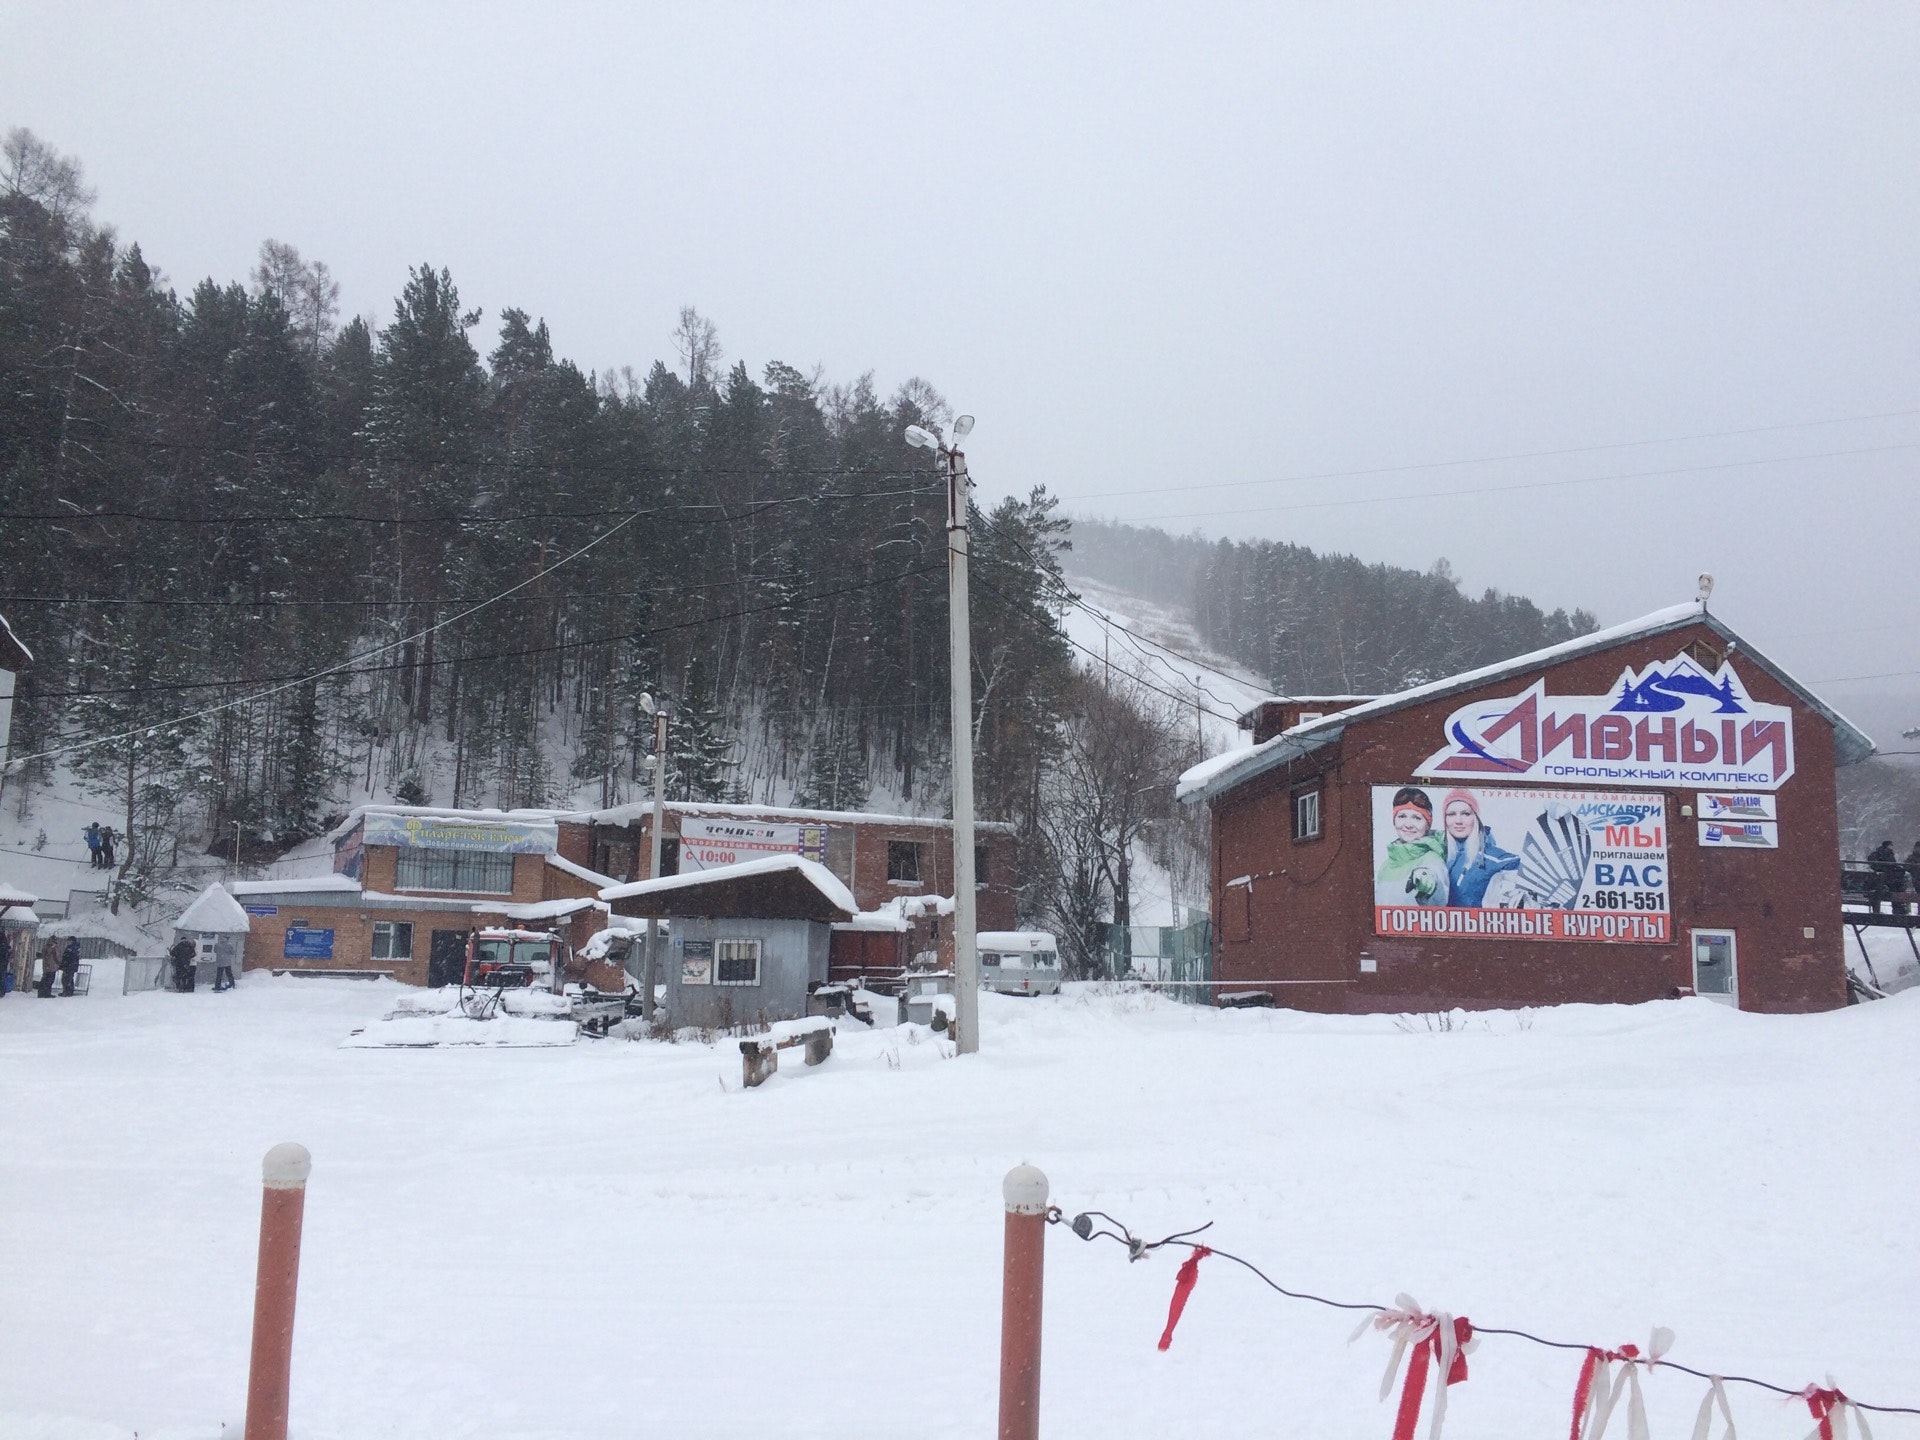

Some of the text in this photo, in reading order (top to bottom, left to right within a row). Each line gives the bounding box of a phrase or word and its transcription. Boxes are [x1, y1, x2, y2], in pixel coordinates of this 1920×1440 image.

[1544, 765, 1769, 783] ГОРНОЛЫЖНЫЙ КОМПЛЕКС
[1481, 790, 1662, 802] ТУРИСТИЧЕСКАЯ КОМПАНИЯ
[1576, 803, 1662, 818] ДИСКАВЕРИ
[1605, 825, 1662, 848] МЫ
[700, 850, 736, 863] 10:00
[1593, 851, 1664, 861] приглашаем
[1595, 863, 1663, 888] ВАС
[1582, 890, 1664, 911] 2-661-551
[1380, 909, 1665, 939] ГОРНОЛЫЖНЫЕ КУРОРТЫ
